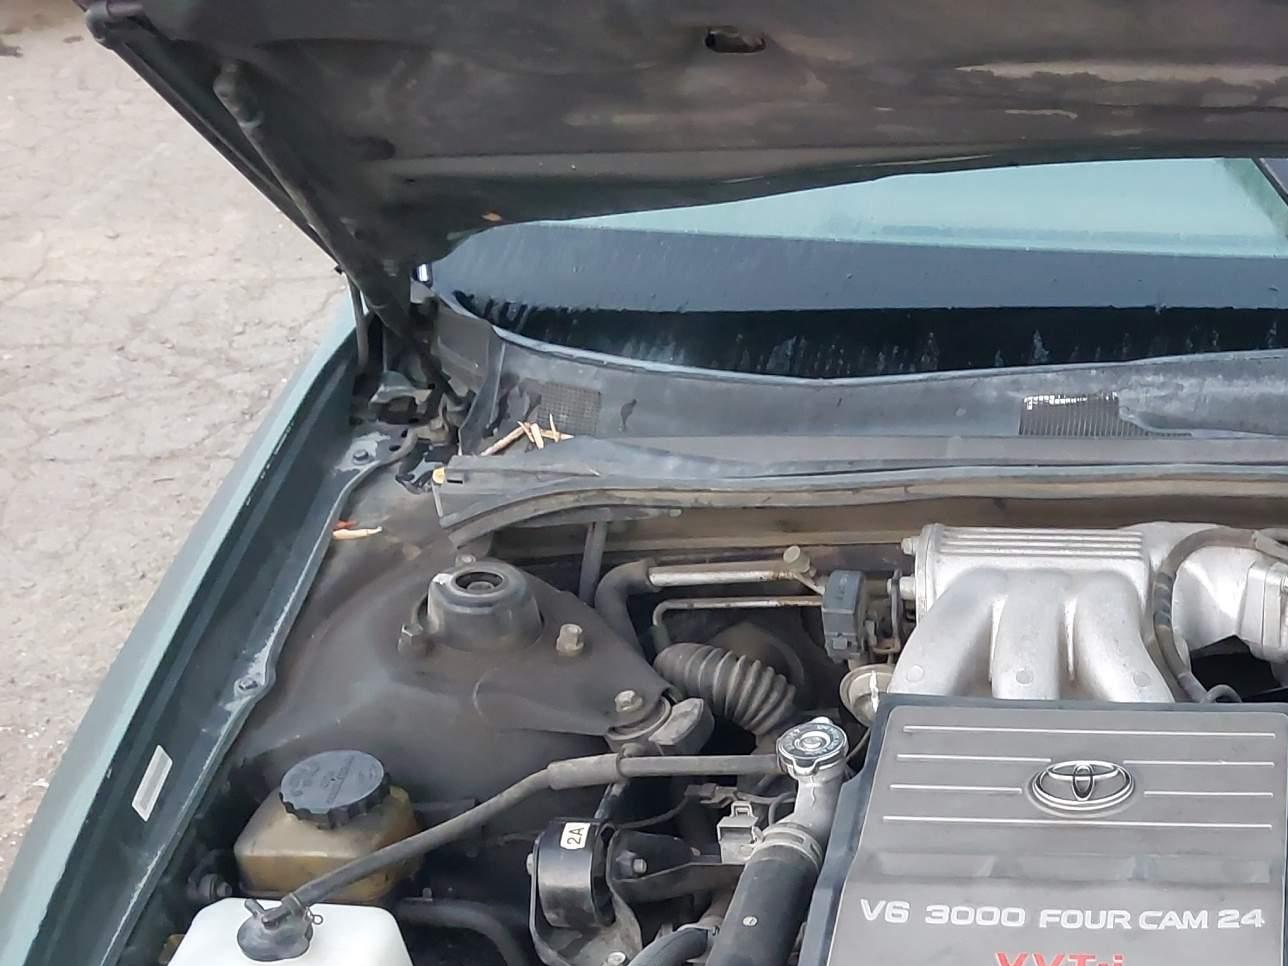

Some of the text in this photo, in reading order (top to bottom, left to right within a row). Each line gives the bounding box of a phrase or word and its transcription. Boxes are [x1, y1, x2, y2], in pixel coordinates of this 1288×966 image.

[567, 827, 585, 845] 2A
[860, 898, 1266, 930] V6 3000 FOUR CAM 24
